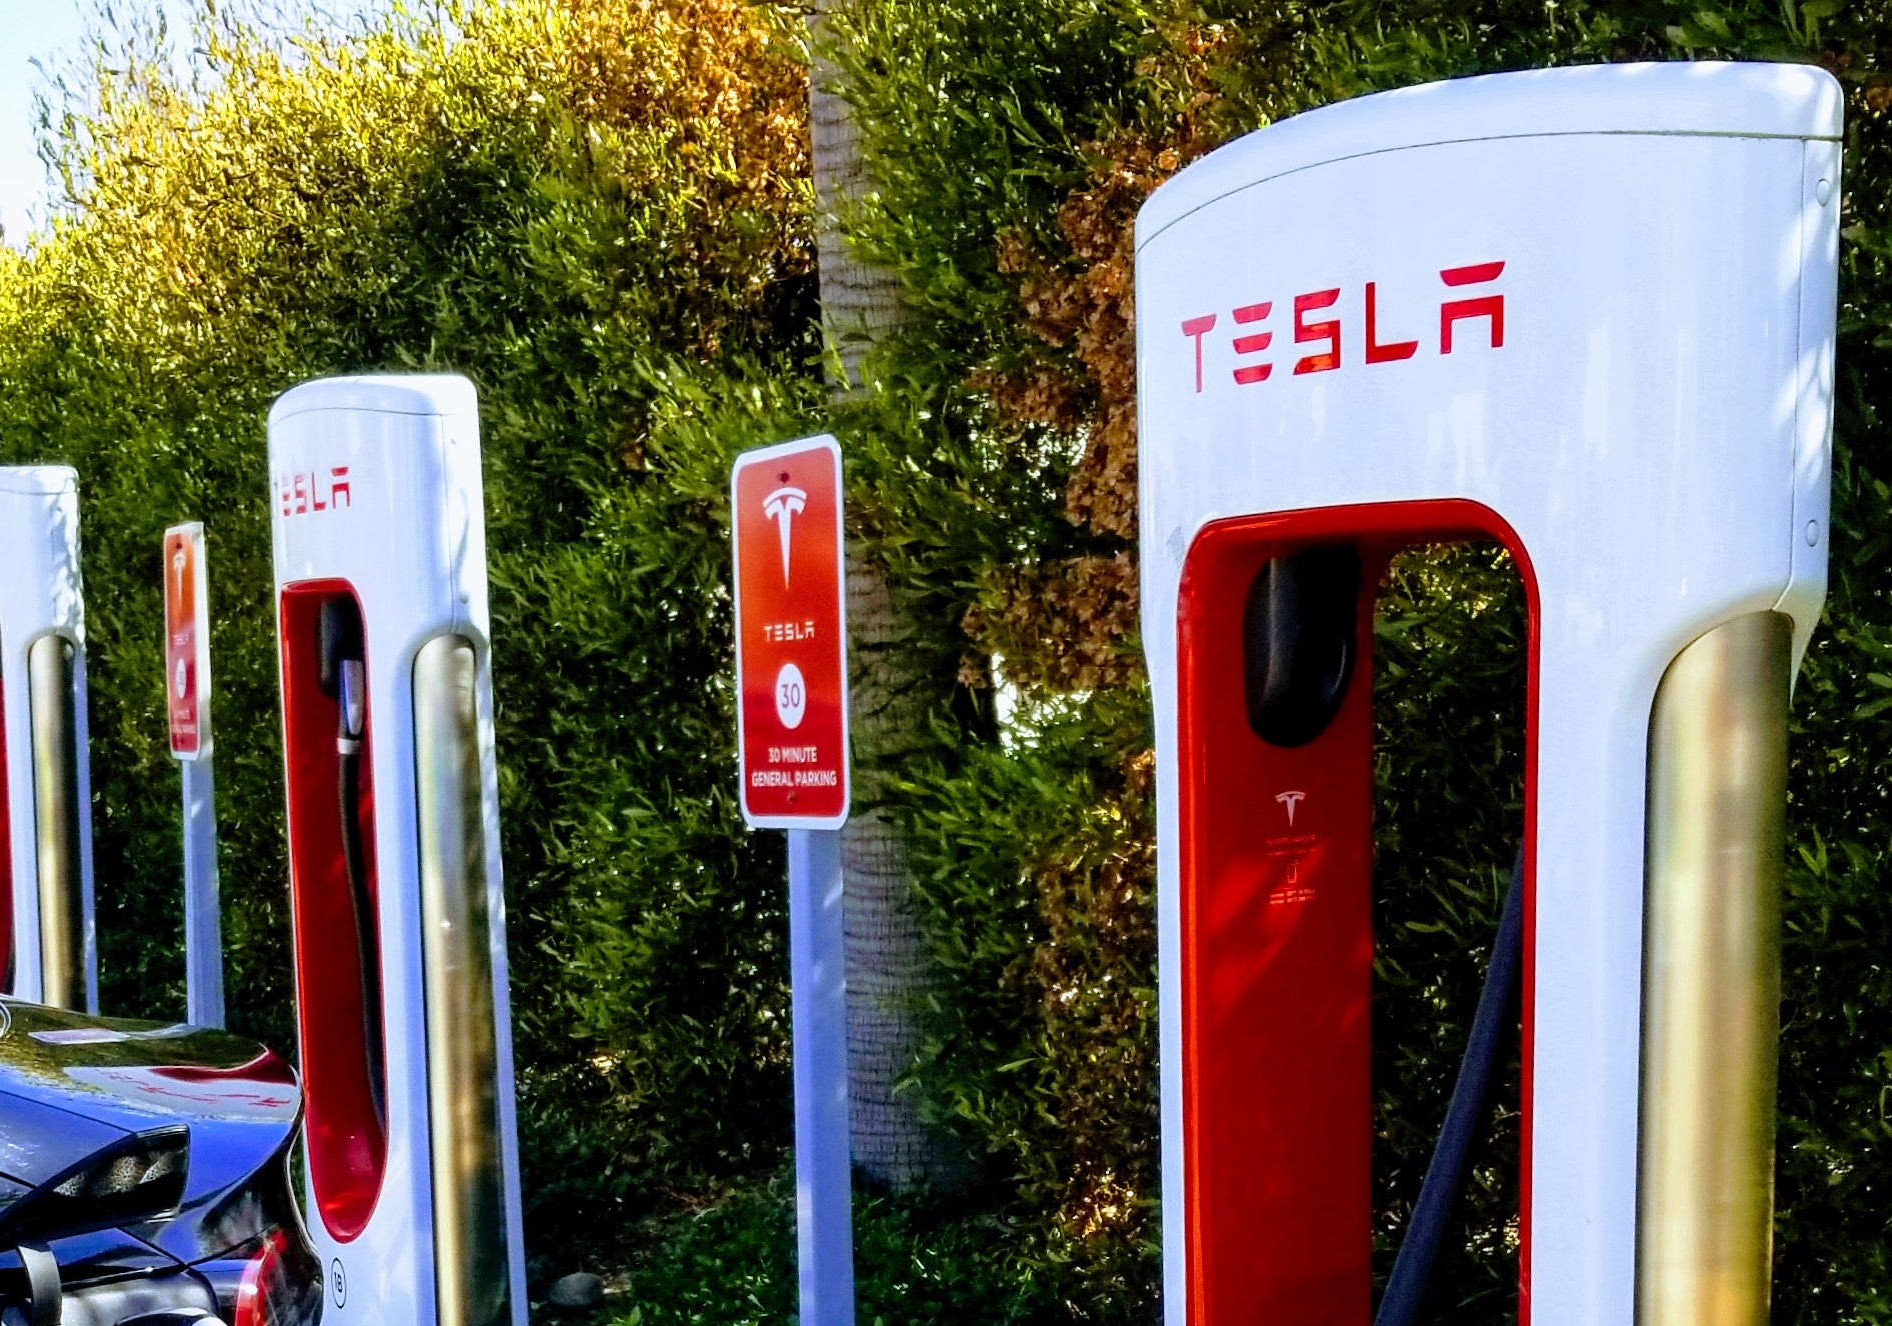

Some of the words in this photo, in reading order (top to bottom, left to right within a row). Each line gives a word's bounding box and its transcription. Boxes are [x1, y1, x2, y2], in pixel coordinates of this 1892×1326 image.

[1181, 261, 1506, 393] TESLA
[281, 466, 350, 517] ESLA
[764, 620, 815, 642] TESLA
[781, 683, 801, 708] 30
[768, 746, 781, 763] 30
[782, 746, 818, 763] MINUTE
[751, 770, 794, 787] GENERAL
[795, 769, 837, 786] PARKING
[334, 1272, 343, 1293] 1B
